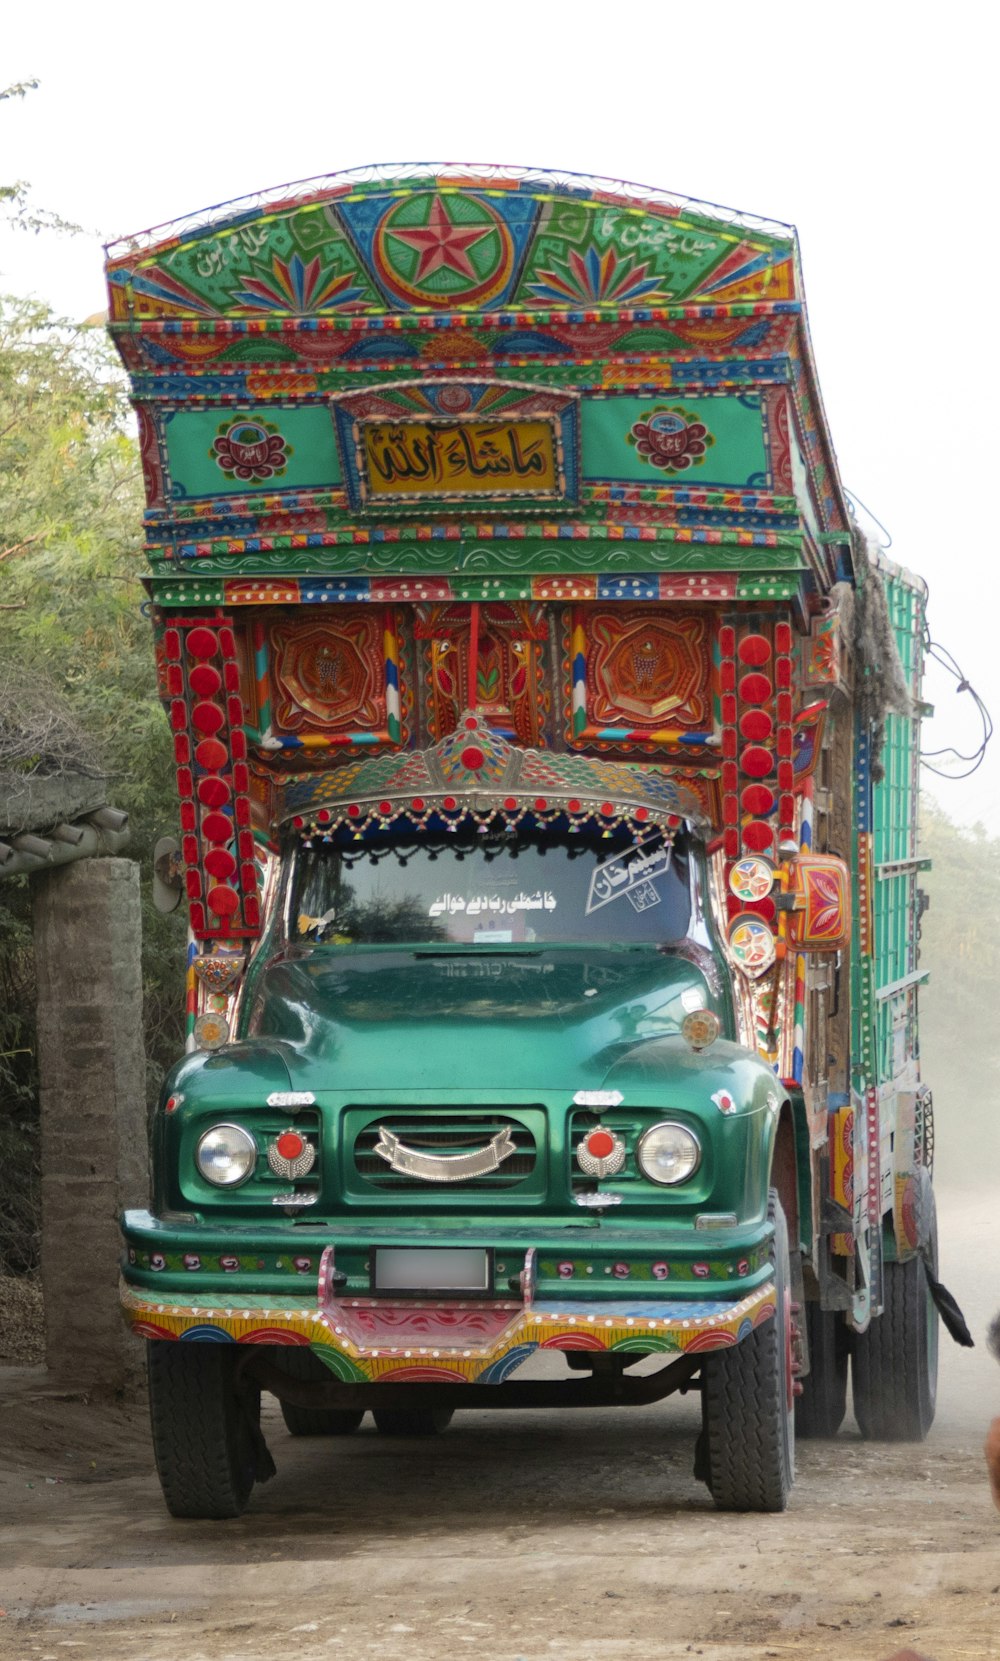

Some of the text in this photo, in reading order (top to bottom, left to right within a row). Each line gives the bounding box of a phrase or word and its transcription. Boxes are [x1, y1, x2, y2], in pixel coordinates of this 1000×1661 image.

[602, 210, 621, 237] کا
[229, 224, 269, 261] غلام
[620, 223, 678, 254] پنجتن
[681, 239, 716, 257] میں
[593, 865, 629, 899] خان
[429, 893, 466, 917] حوالے
